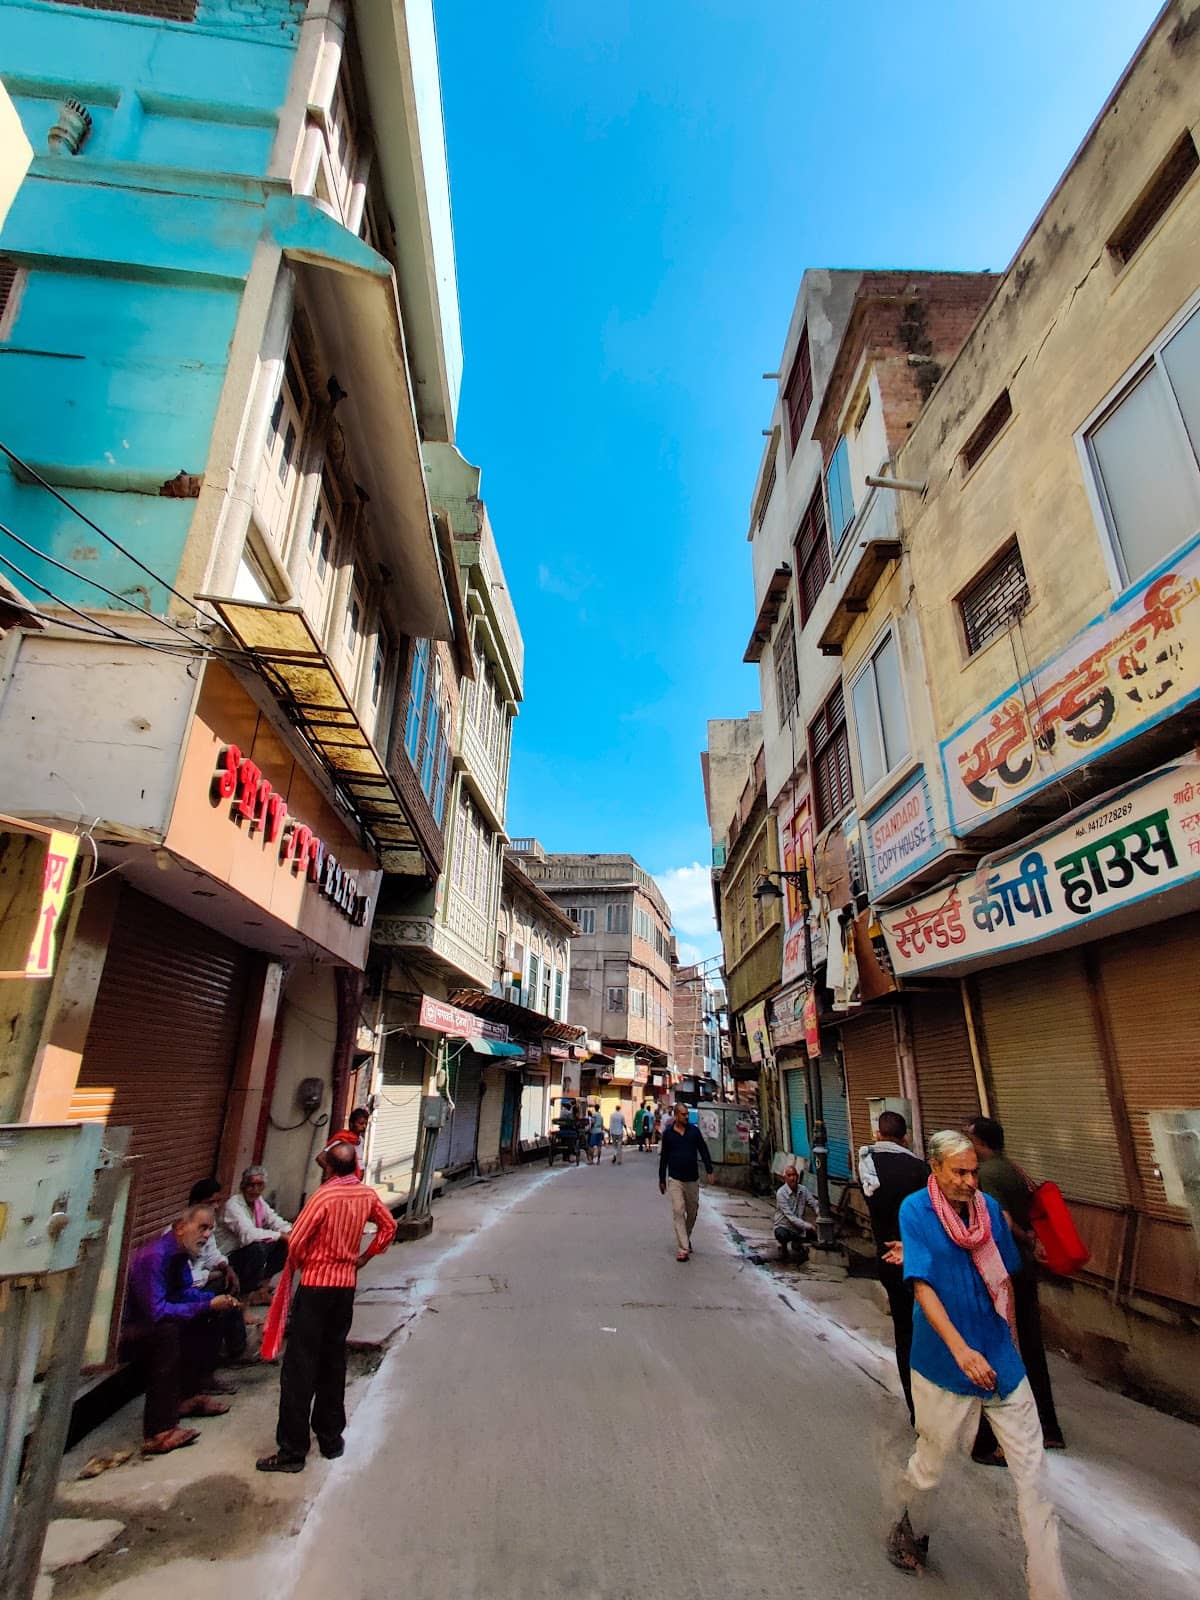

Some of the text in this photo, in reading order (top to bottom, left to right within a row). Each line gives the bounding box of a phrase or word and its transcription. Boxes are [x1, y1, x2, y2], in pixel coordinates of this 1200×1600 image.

[874, 796, 920, 850] STANDARD
[1088, 802, 1132, 831] 9412728289
[877, 821, 927, 875] COPY HOUSE
[968, 852, 1053, 933] कॉपी
[1054, 808, 1179, 916] हाउस
